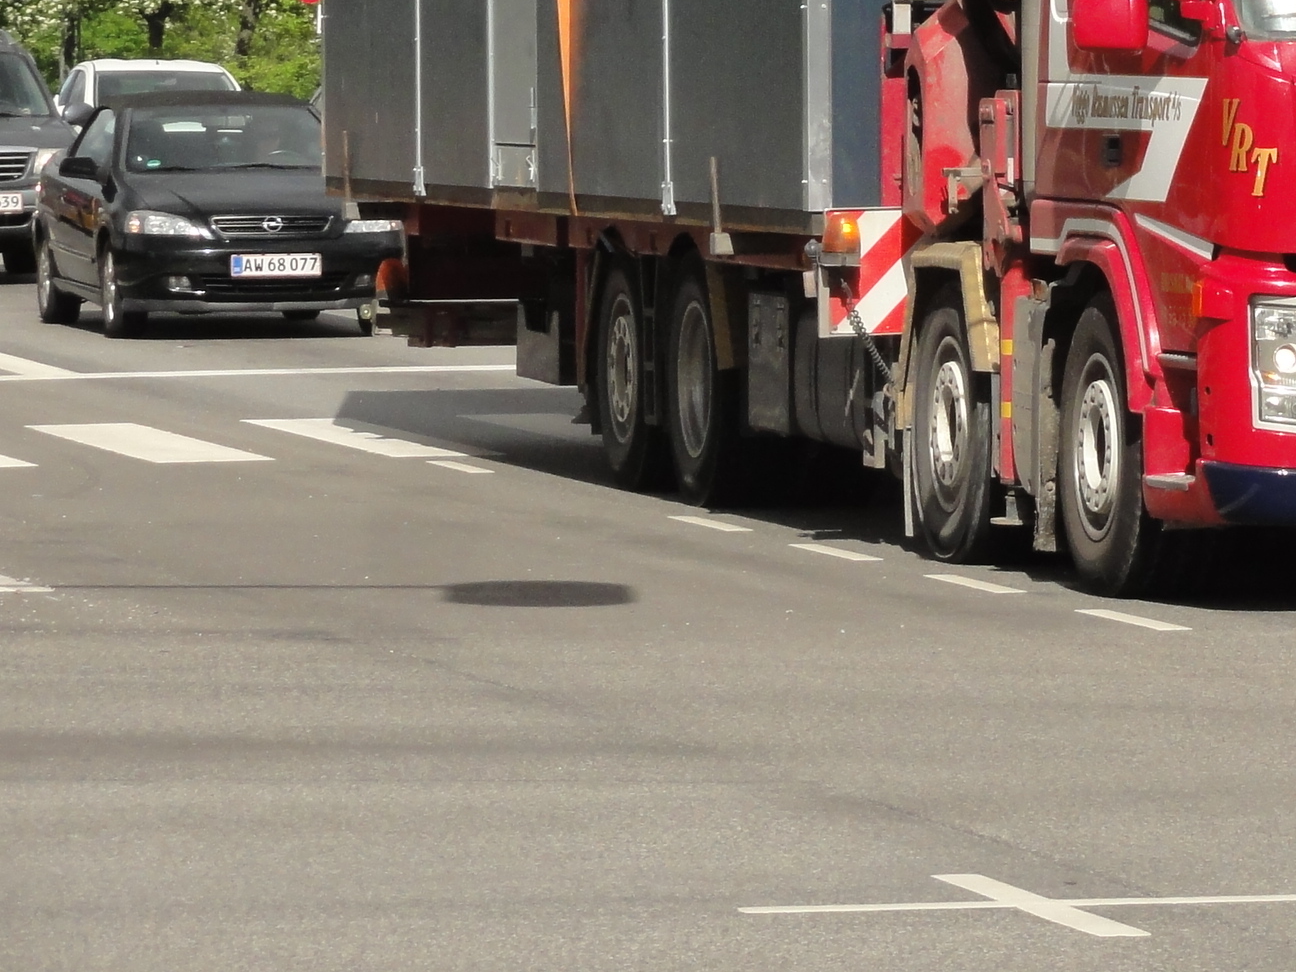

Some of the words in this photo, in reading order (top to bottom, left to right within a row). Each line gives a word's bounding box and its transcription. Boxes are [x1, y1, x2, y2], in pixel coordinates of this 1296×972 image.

[1222, 98, 1278, 197] VRT
[0, 195, 19, 208] 39
[244, 258, 264, 272] AW
[268, 258, 286, 272] 68
[290, 257, 318, 271] 077
